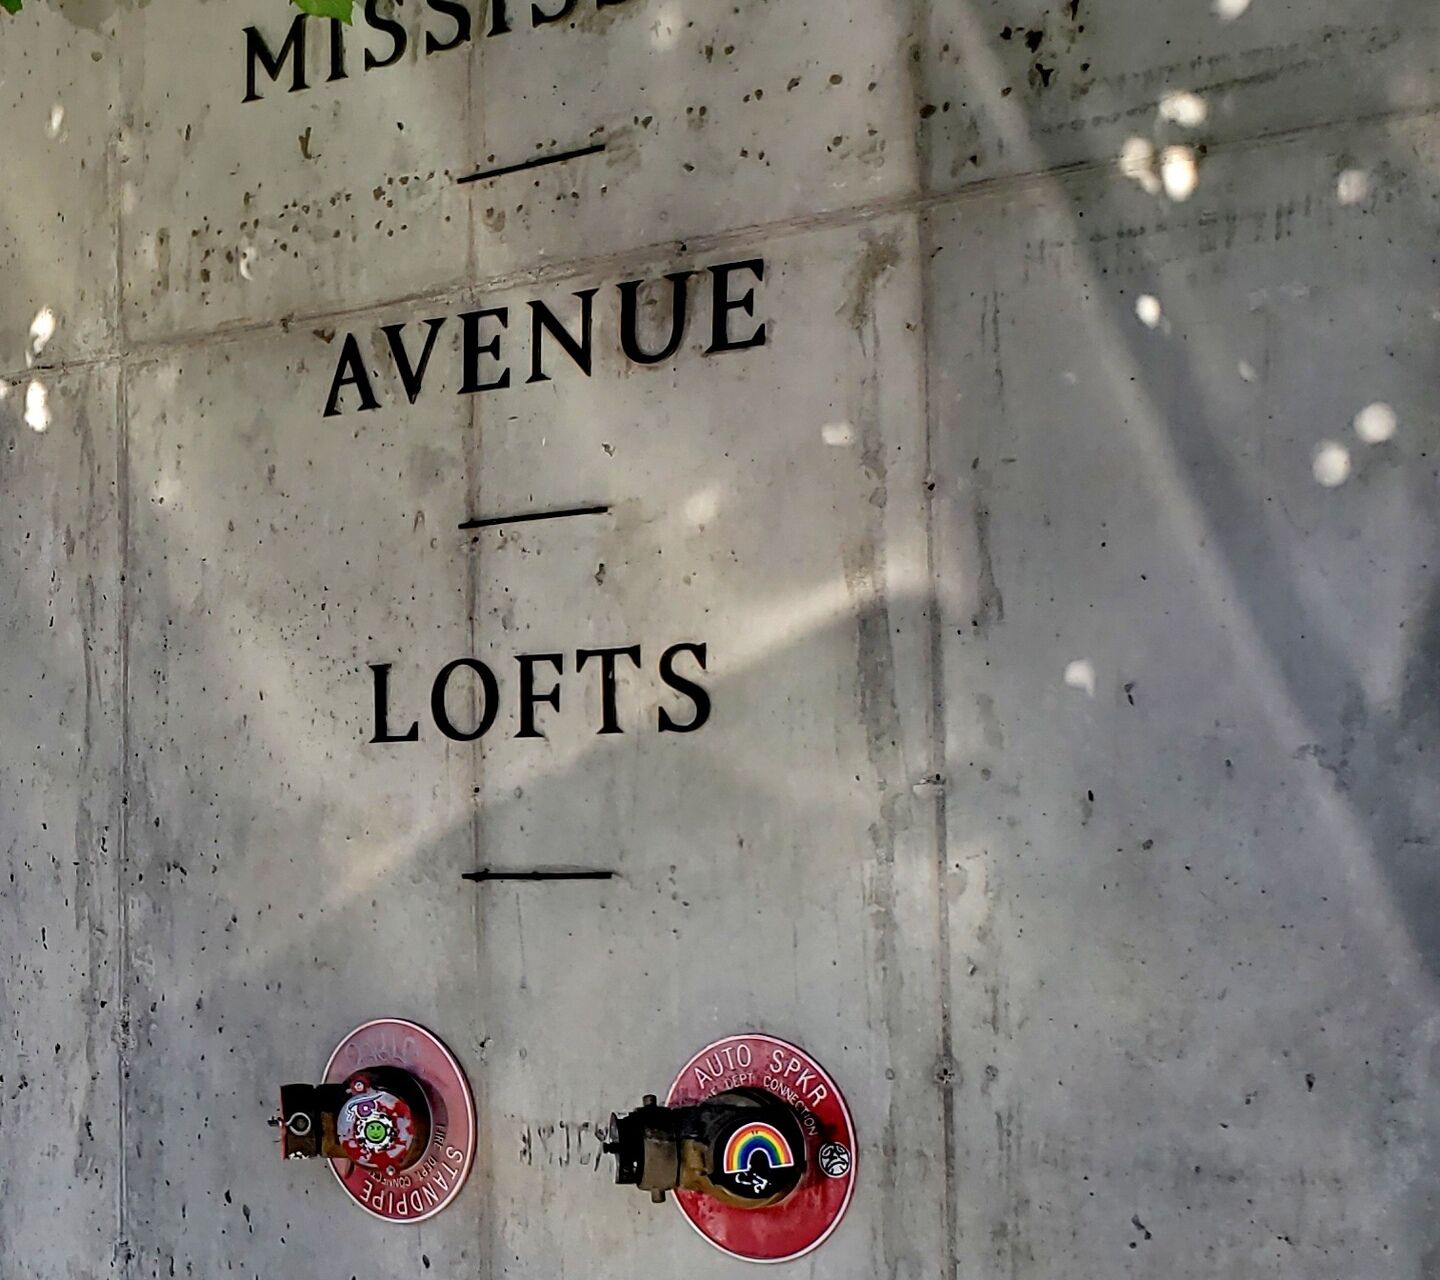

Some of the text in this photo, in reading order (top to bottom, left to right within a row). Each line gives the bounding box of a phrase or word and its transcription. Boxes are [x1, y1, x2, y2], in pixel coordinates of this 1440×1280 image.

[323, 257, 768, 418] AVENUE
[368, 642, 712, 744] LOFTS
[693, 1043, 829, 1108] AUTO SPKR
[763, 1075, 819, 1137] CONNECTION
[359, 1146, 464, 1216] STANDPIPE
